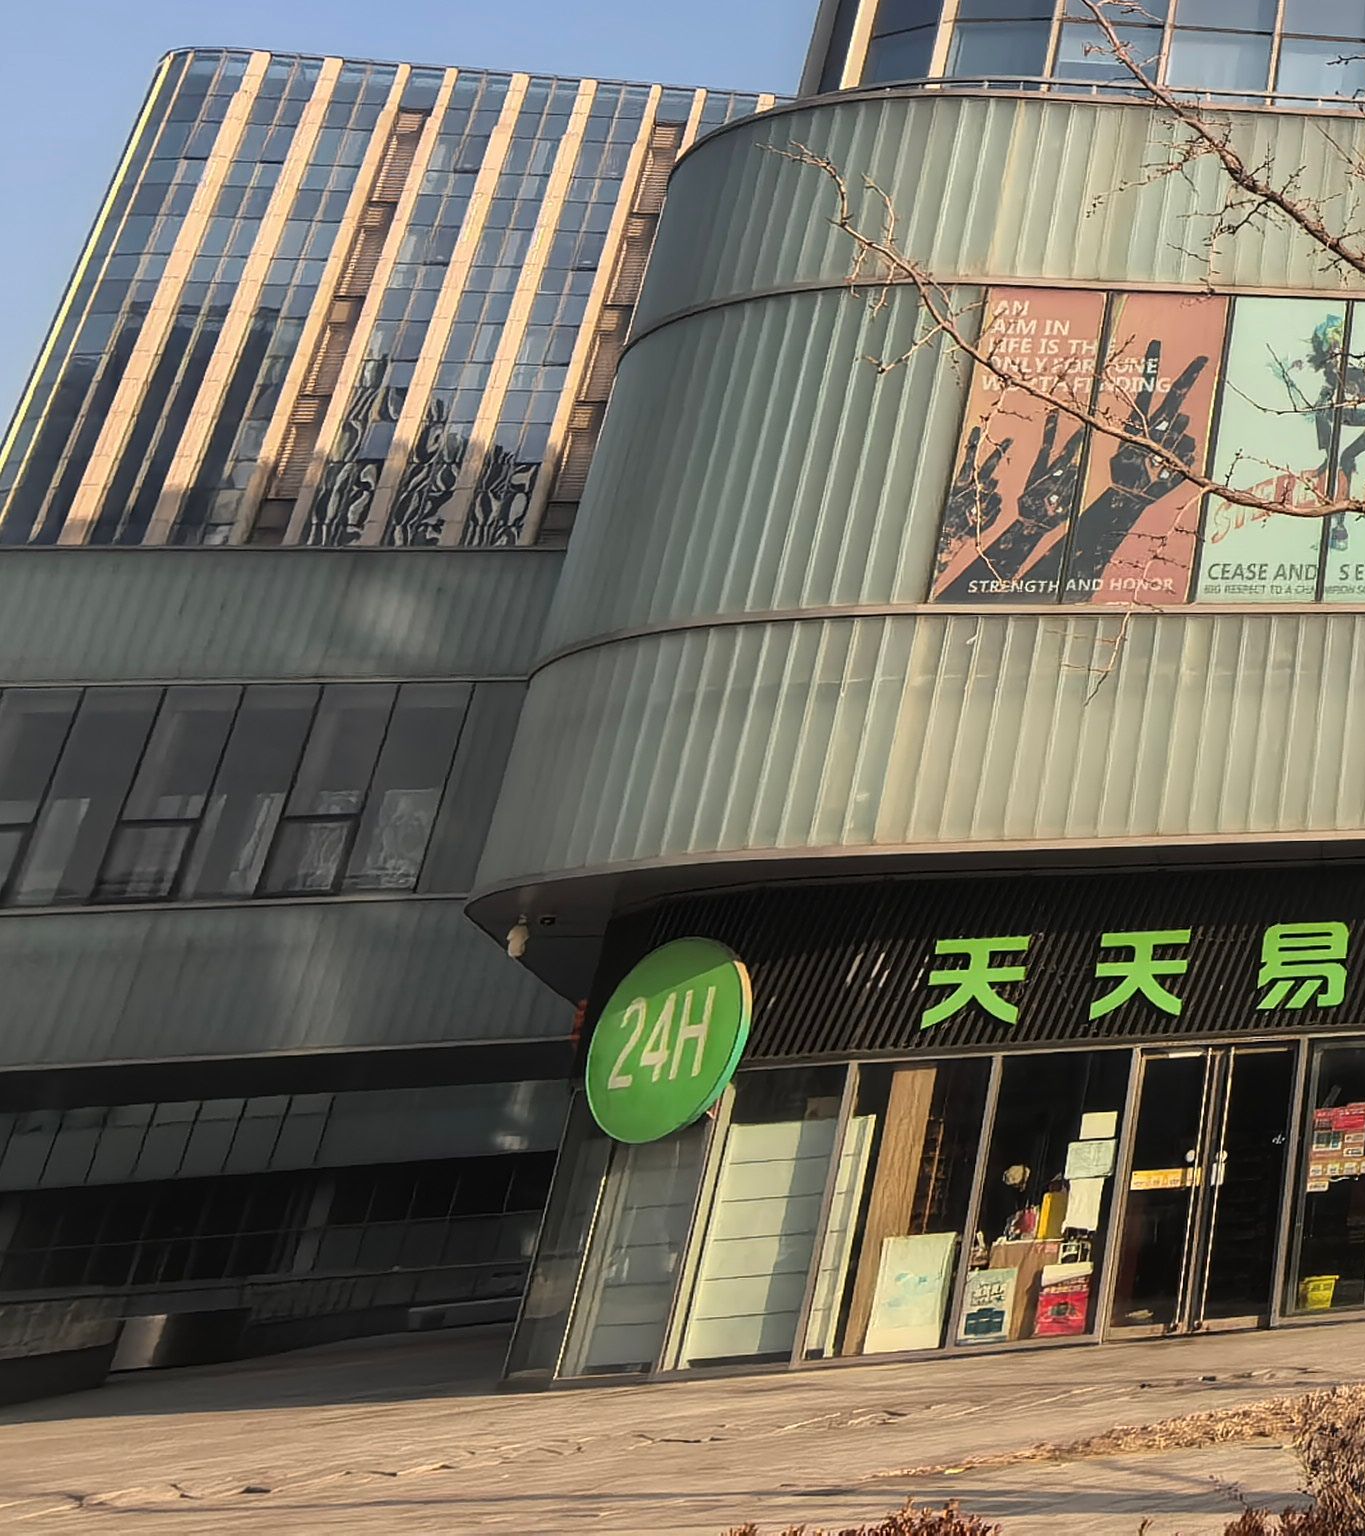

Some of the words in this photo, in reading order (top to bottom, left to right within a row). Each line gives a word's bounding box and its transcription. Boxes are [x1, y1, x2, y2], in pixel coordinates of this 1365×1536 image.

[990, 319, 1037, 335] AIM
[1044, 320, 1070, 336] IN
[1038, 338, 1060, 354] IS
[1207, 563, 1269, 581] CEASE
[1273, 563, 1318, 581] AND
[967, 579, 1060, 594] STRENGTH
[1065, 578, 1104, 591] AND
[1109, 577, 1174, 591] HONOR
[607, 985, 717, 1091] 24H
